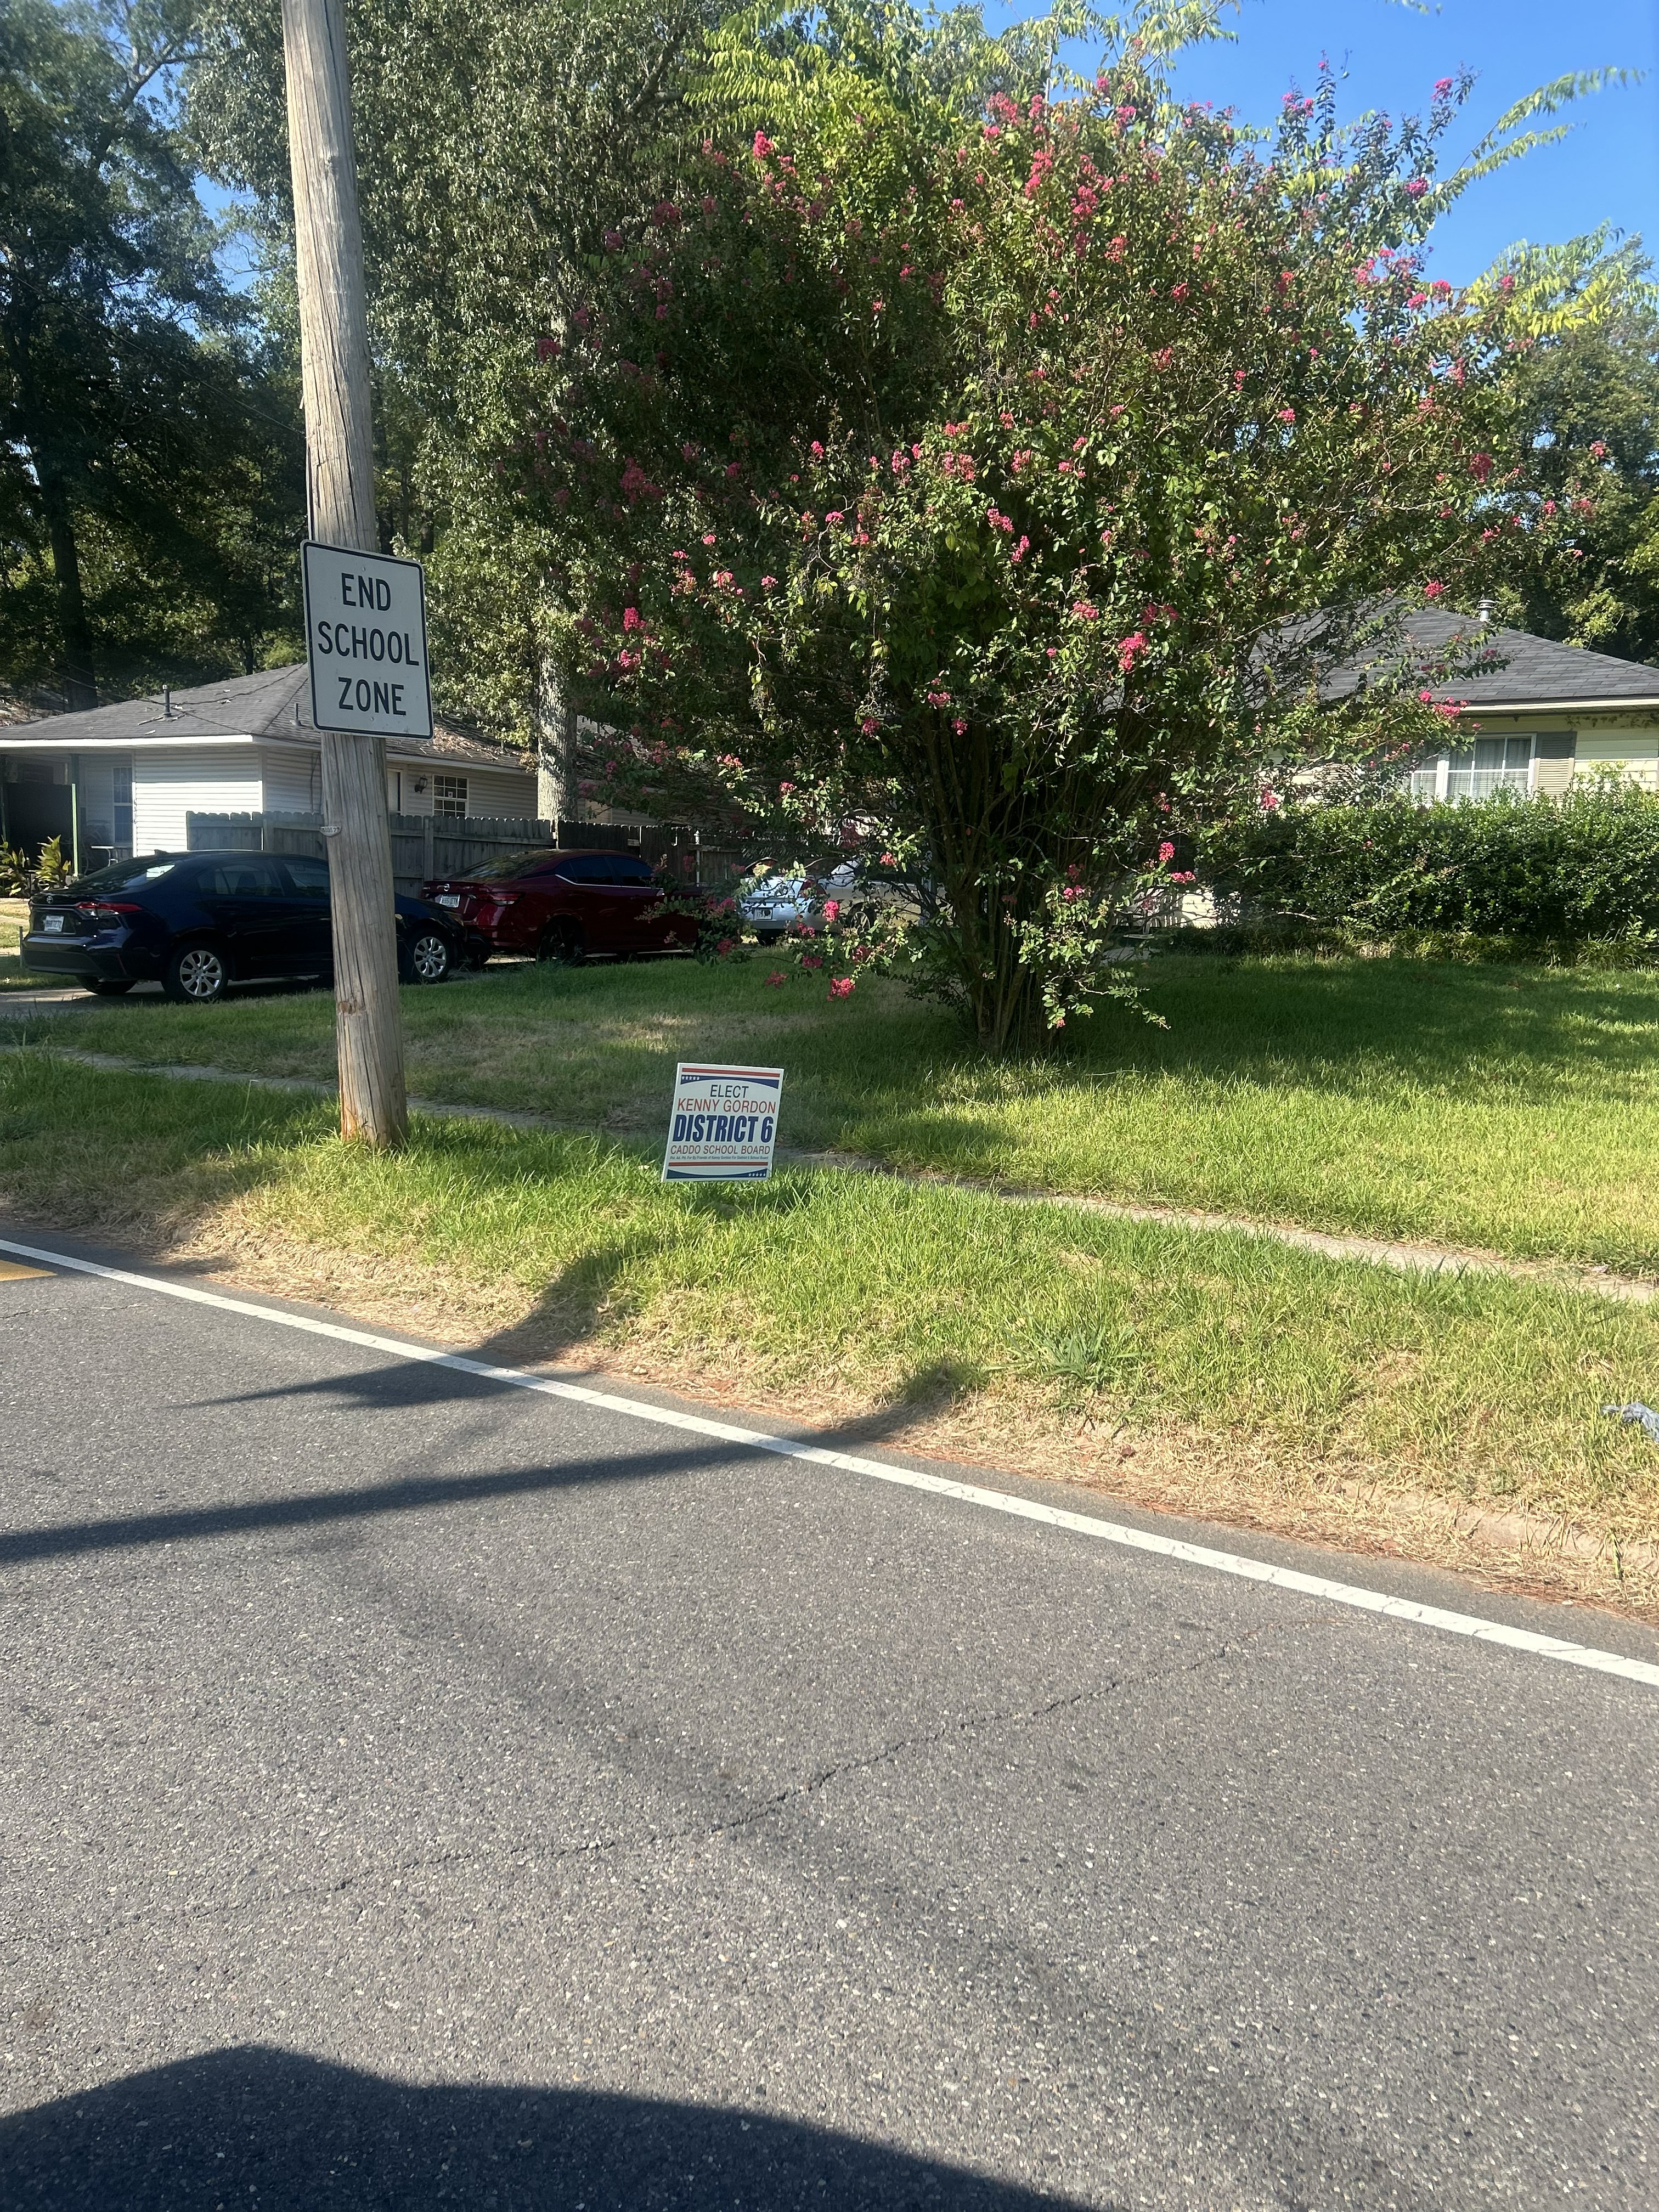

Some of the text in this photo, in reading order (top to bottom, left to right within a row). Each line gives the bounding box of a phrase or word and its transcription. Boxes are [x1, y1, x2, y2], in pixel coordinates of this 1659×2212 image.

[341, 572, 392, 612] END
[318, 620, 420, 666] SCHOOL
[338, 676, 407, 716] ZONE
[677, 1098, 776, 1114] KENNY GORDON
[710, 1085, 749, 1098] ELECT
[672, 1114, 774, 1143] DISTRICT 6
[670, 1145, 770, 1154] CADDO SCHOOL BOARD
